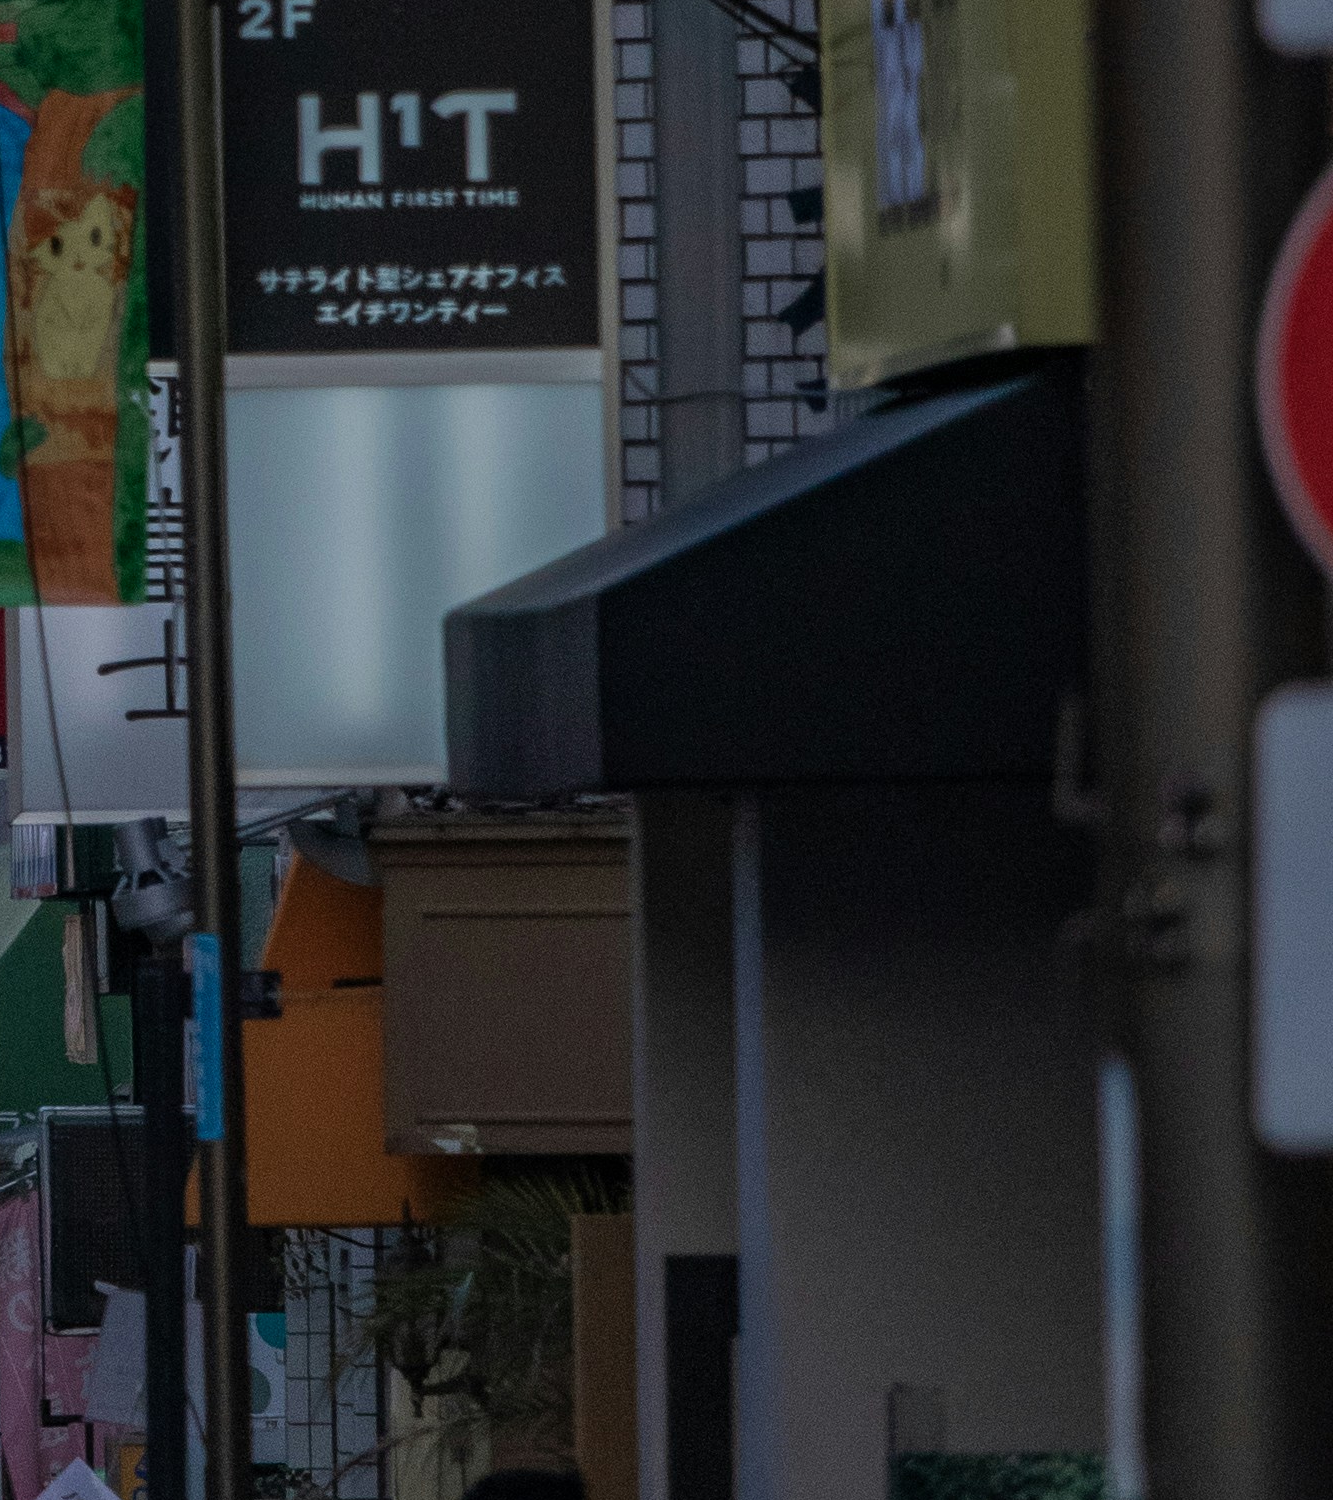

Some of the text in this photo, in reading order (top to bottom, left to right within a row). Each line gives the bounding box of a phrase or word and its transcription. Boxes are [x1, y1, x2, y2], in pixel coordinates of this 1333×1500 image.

[299, 189, 520, 210] HUMAN FIRST TIME
[315, 300, 512, 326] エイチワンティー
